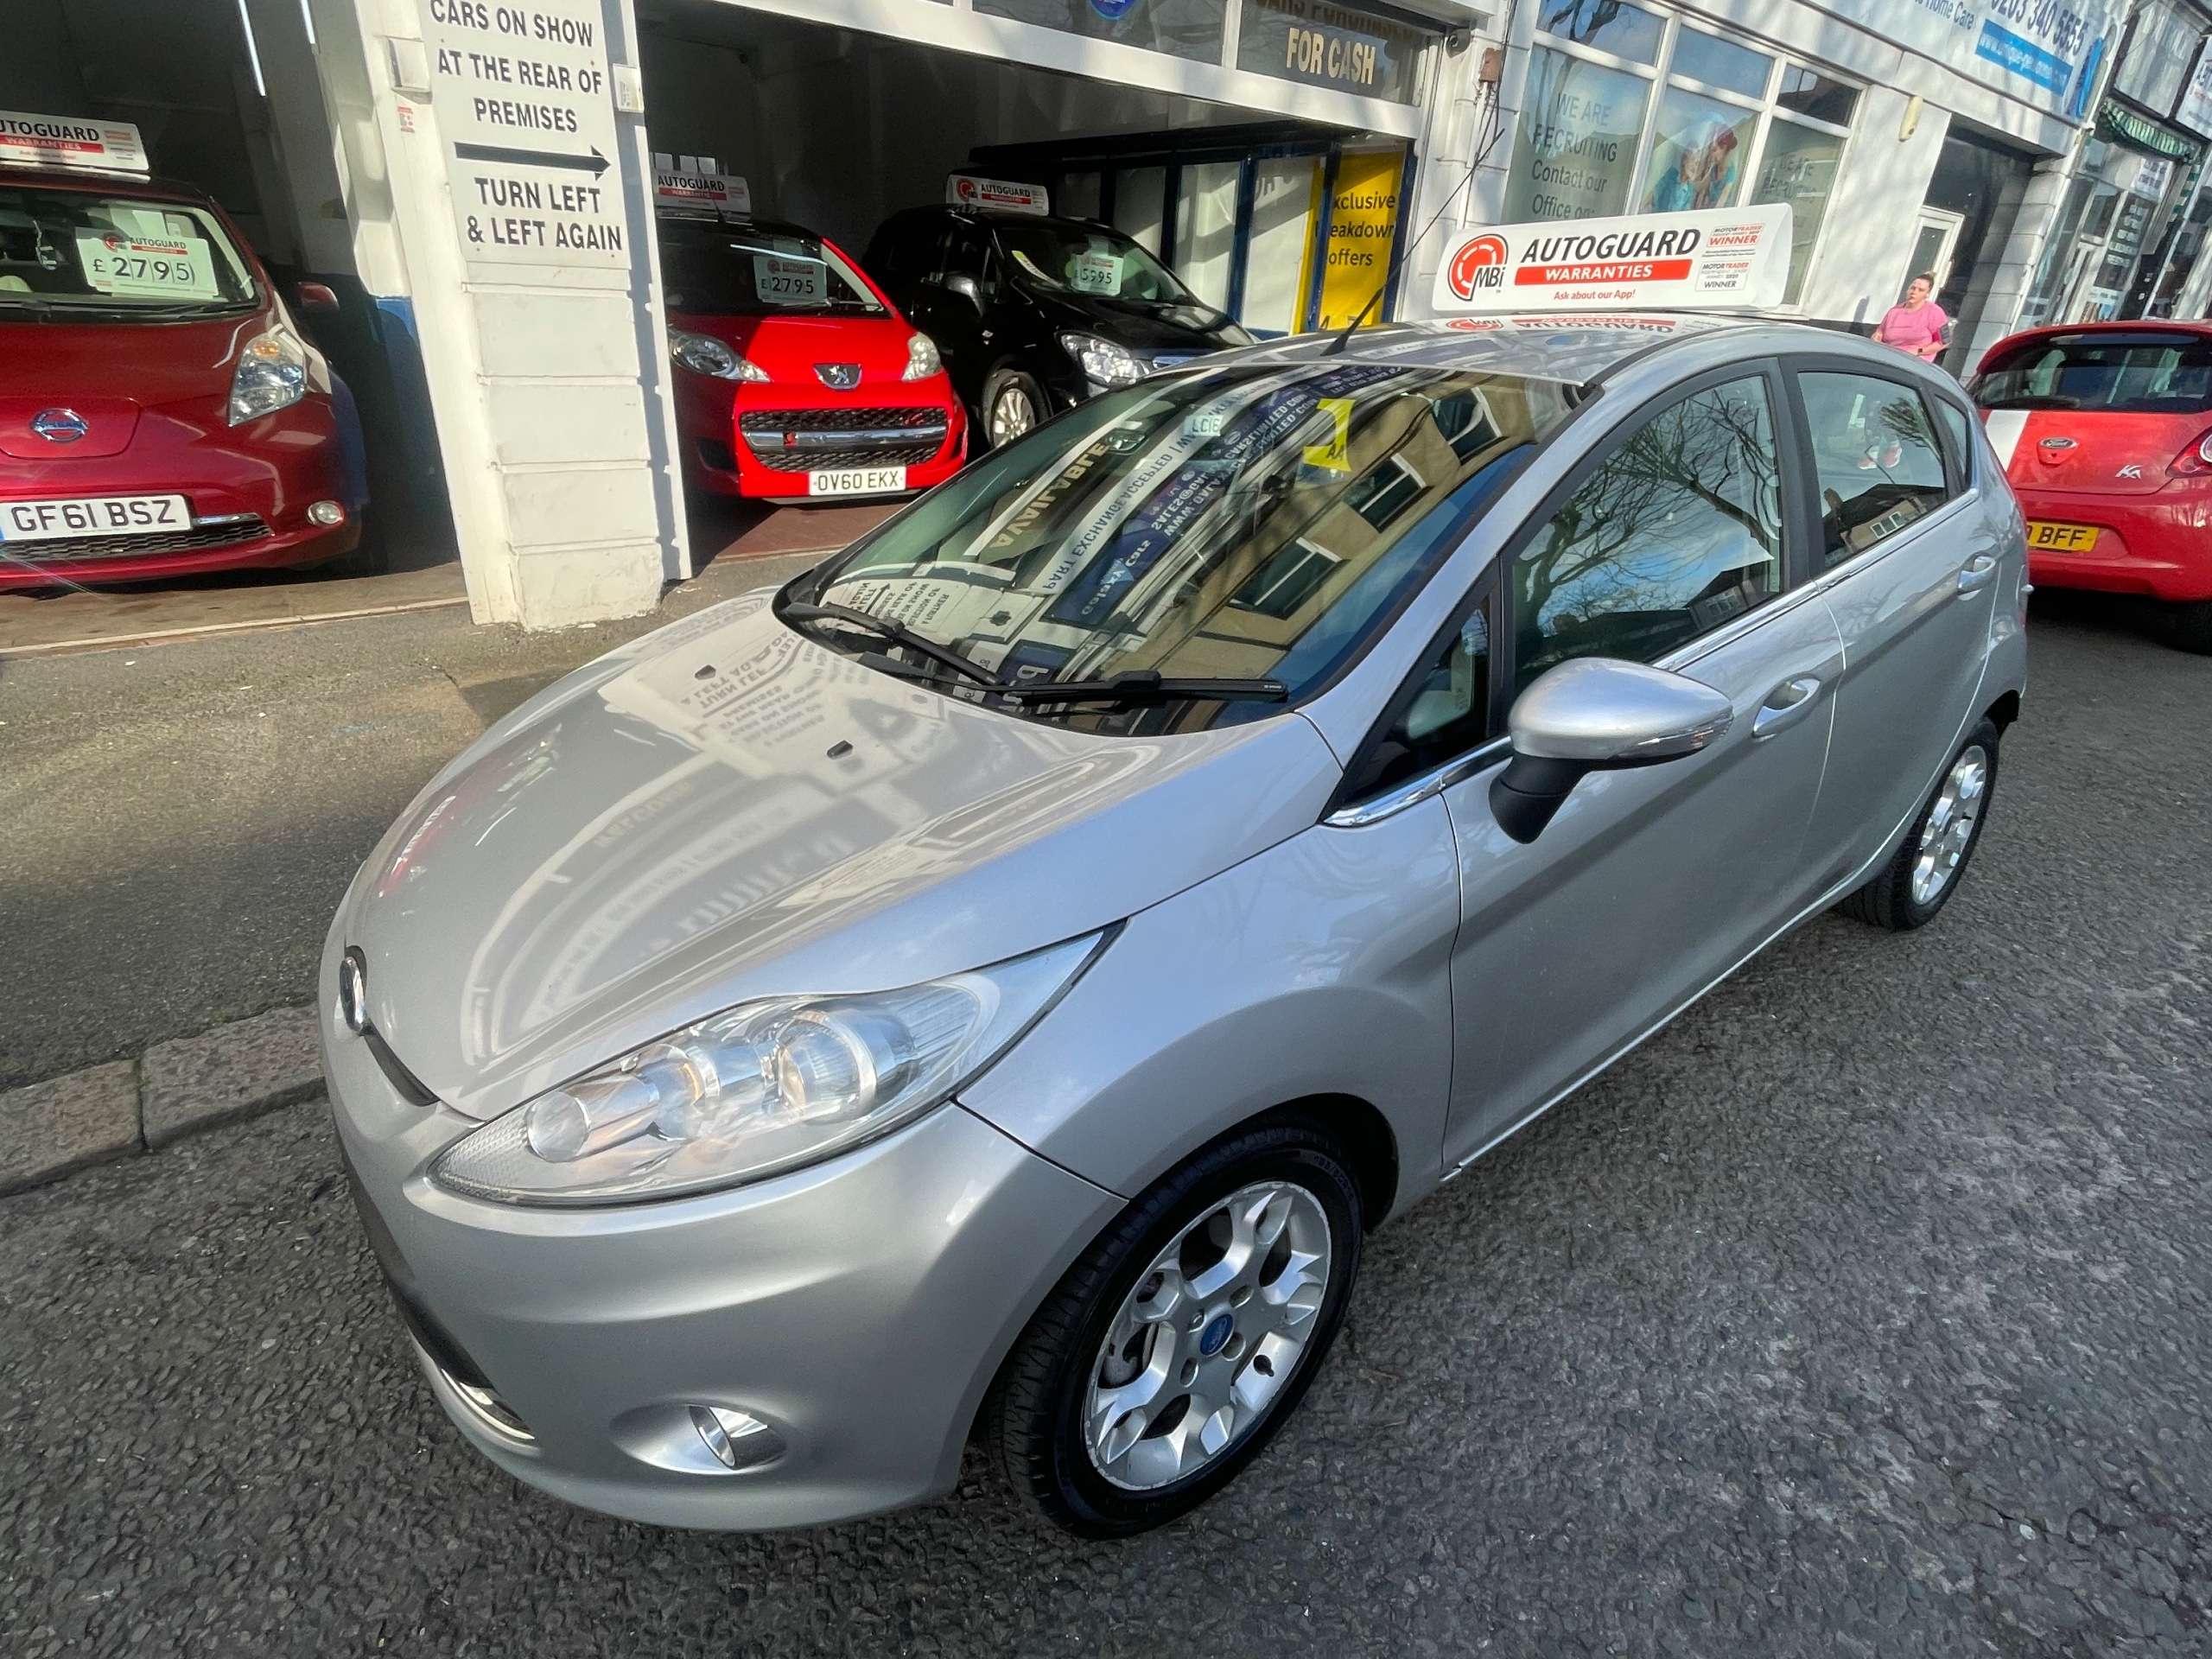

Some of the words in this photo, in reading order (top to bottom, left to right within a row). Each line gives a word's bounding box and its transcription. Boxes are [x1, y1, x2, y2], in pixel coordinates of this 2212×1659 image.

[429, 0, 489, 30] CARS
[496, 7, 527, 36] ON
[533, 13, 593, 48] SHOW
[1954, 1, 1975, 29] Care
[1286, 27, 1323, 75] FOR
[1327, 35, 1376, 86] CASH
[438, 48, 462, 76] AT
[468, 53, 512, 84] THE
[518, 60, 572, 91] REAR
[578, 68, 602, 94] OF
[474, 97, 577, 133] PREMISES
[1554, 92, 1580, 118] WE
[1581, 100, 1611, 126] ARE
[658, 175, 725, 191] AUTOGUARD
[1532, 159, 1583, 188] Contact
[1586, 176, 1607, 192] our
[474, 176, 541, 209] TURN
[549, 183, 601, 213] LEFT
[981, 183, 1031, 197] AUTOGUARD
[1333, 191, 1396, 210] xclusive
[1532, 194, 1571, 219] Office
[467, 215, 486, 243] &
[491, 217, 546, 246] LEFT
[556, 222, 623, 251] AGAIN
[1315, 220, 1395, 239] eakdown
[1709, 235, 1758, 245] WINNER
[130, 238, 187, 249] AUTOGUARD
[1521, 228, 1701, 264] AUTOGUARD
[1328, 249, 1373, 266] offers
[1545, 264, 1653, 282] WARRANTIES
[1554, 289, 1570, 301] Ask
[1572, 289, 1592, 301] about
[1614, 289, 1636, 301] App!
[817, 473, 862, 491] OV60
[868, 471, 899, 488] EKX
[10, 503, 99, 533] GF61
[104, 499, 177, 528] BSZ
[2037, 526, 2087, 546] BFF
